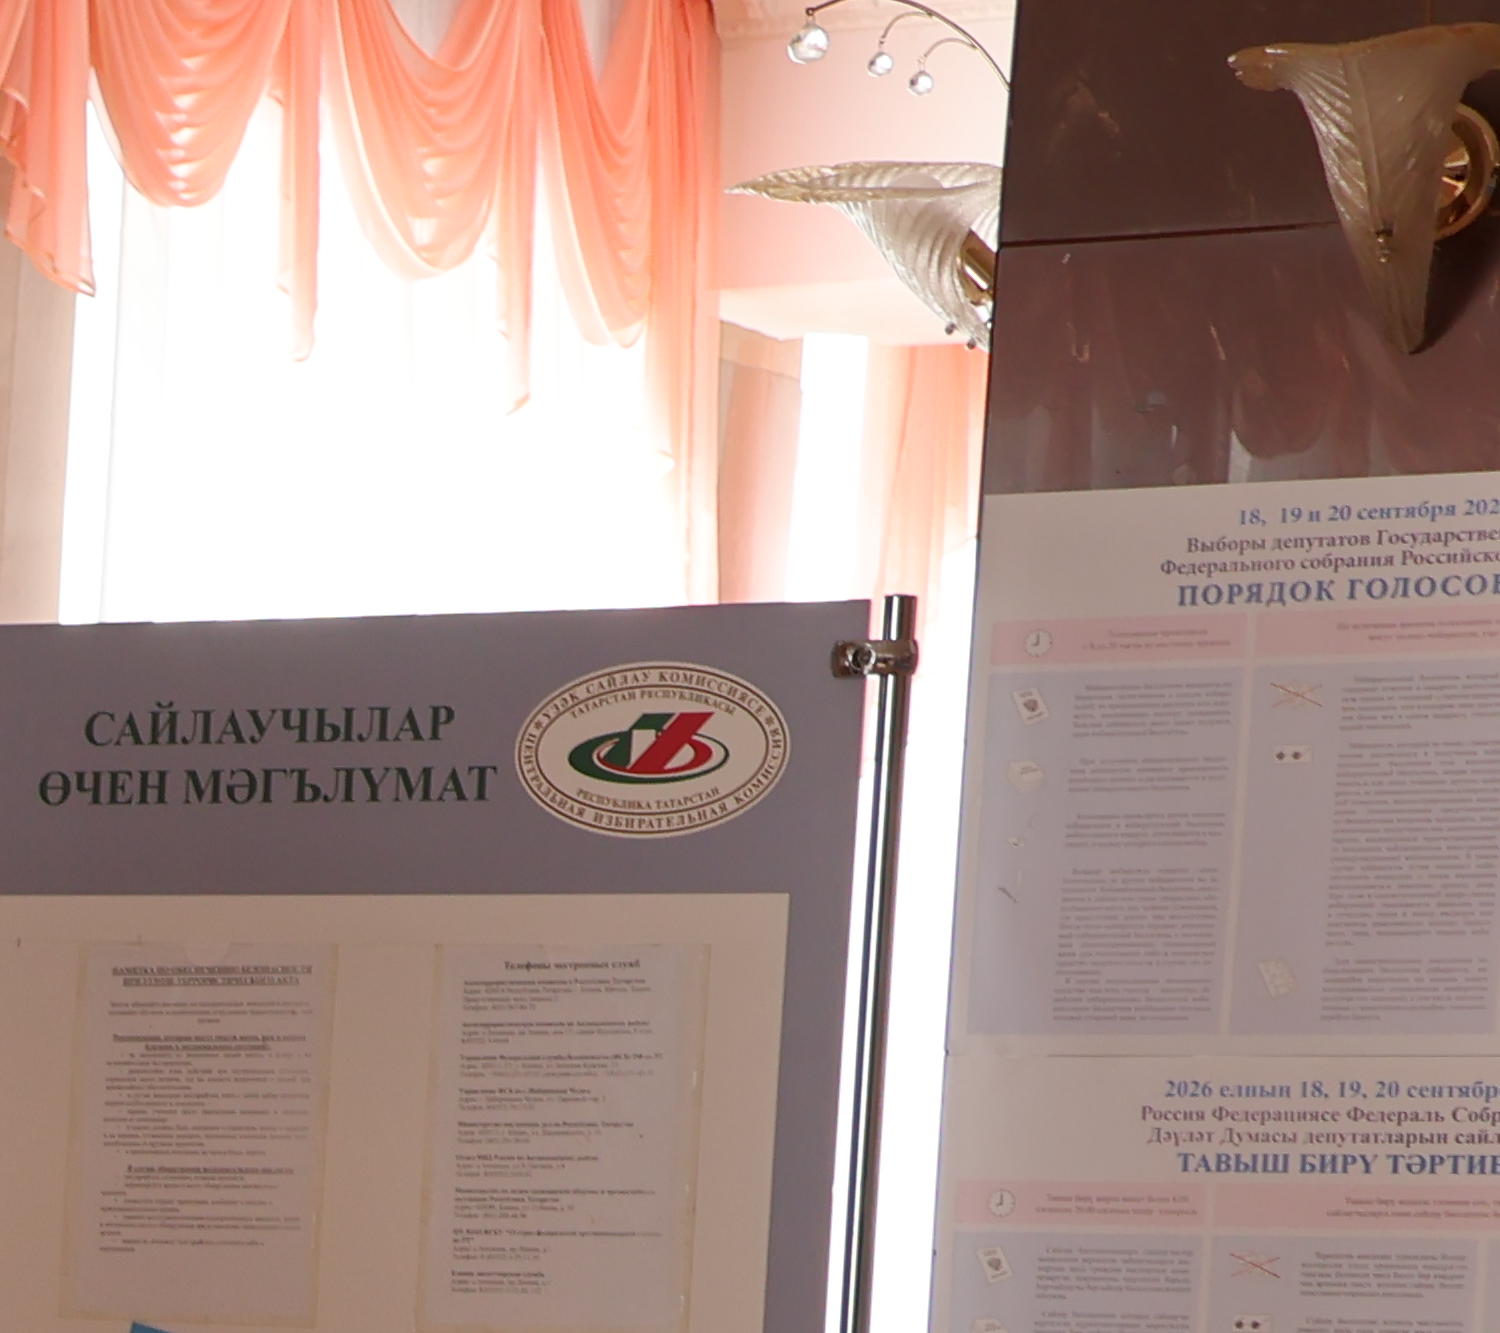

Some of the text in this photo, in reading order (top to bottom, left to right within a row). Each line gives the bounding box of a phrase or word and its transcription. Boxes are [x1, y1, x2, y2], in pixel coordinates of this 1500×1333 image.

[1240, 508, 1267, 527] 18,
[1281, 507, 1303, 524] 19
[1307, 509, 1322, 523] и
[1327, 504, 1352, 522] 20
[1356, 501, 1456, 524] сентября
[1186, 528, 1500, 556] Выборы депутатов Государстве
[1160, 558, 1296, 578] Федерального
[1300, 553, 1394, 574] собрания
[1177, 580, 1336, 608] ПОРЯДОК
[570, 689, 737, 719] ТАТАРСТАН РЕСПУБЛИКАСЫ
[585, 671, 651, 697] САЙЛАУ
[658, 670, 766, 716] КОМИССИЯСЕ
[83, 700, 457, 748] САЙЛАУЧЫЛАР
[37, 765, 500, 808] ӨЧЕН МӘГЪЛҮМАТ
[576, 786, 721, 811] РЕСПУБЛИКА ТАТАРСТАН
[593, 802, 729, 830] ИЗБИРАТЕЛЬНАЯ
[1164, 1079, 1213, 1099] 2026
[1375, 1080, 1401, 1099] 20
[1406, 1080, 1500, 1104] сентябр
[1141, 1105, 1206, 1122] Россия
[1211, 1105, 1341, 1126] Федерациясе
[1346, 1106, 1446, 1127] Федераль
[1147, 1126, 1214, 1148] Дәүләт
[1219, 1126, 1298, 1148] Думасы
[1304, 1131, 1449, 1149] депутатларын
[1177, 1152, 1291, 1175] ТАВЫШ
[1299, 1152, 1379, 1175] БИРҮ
